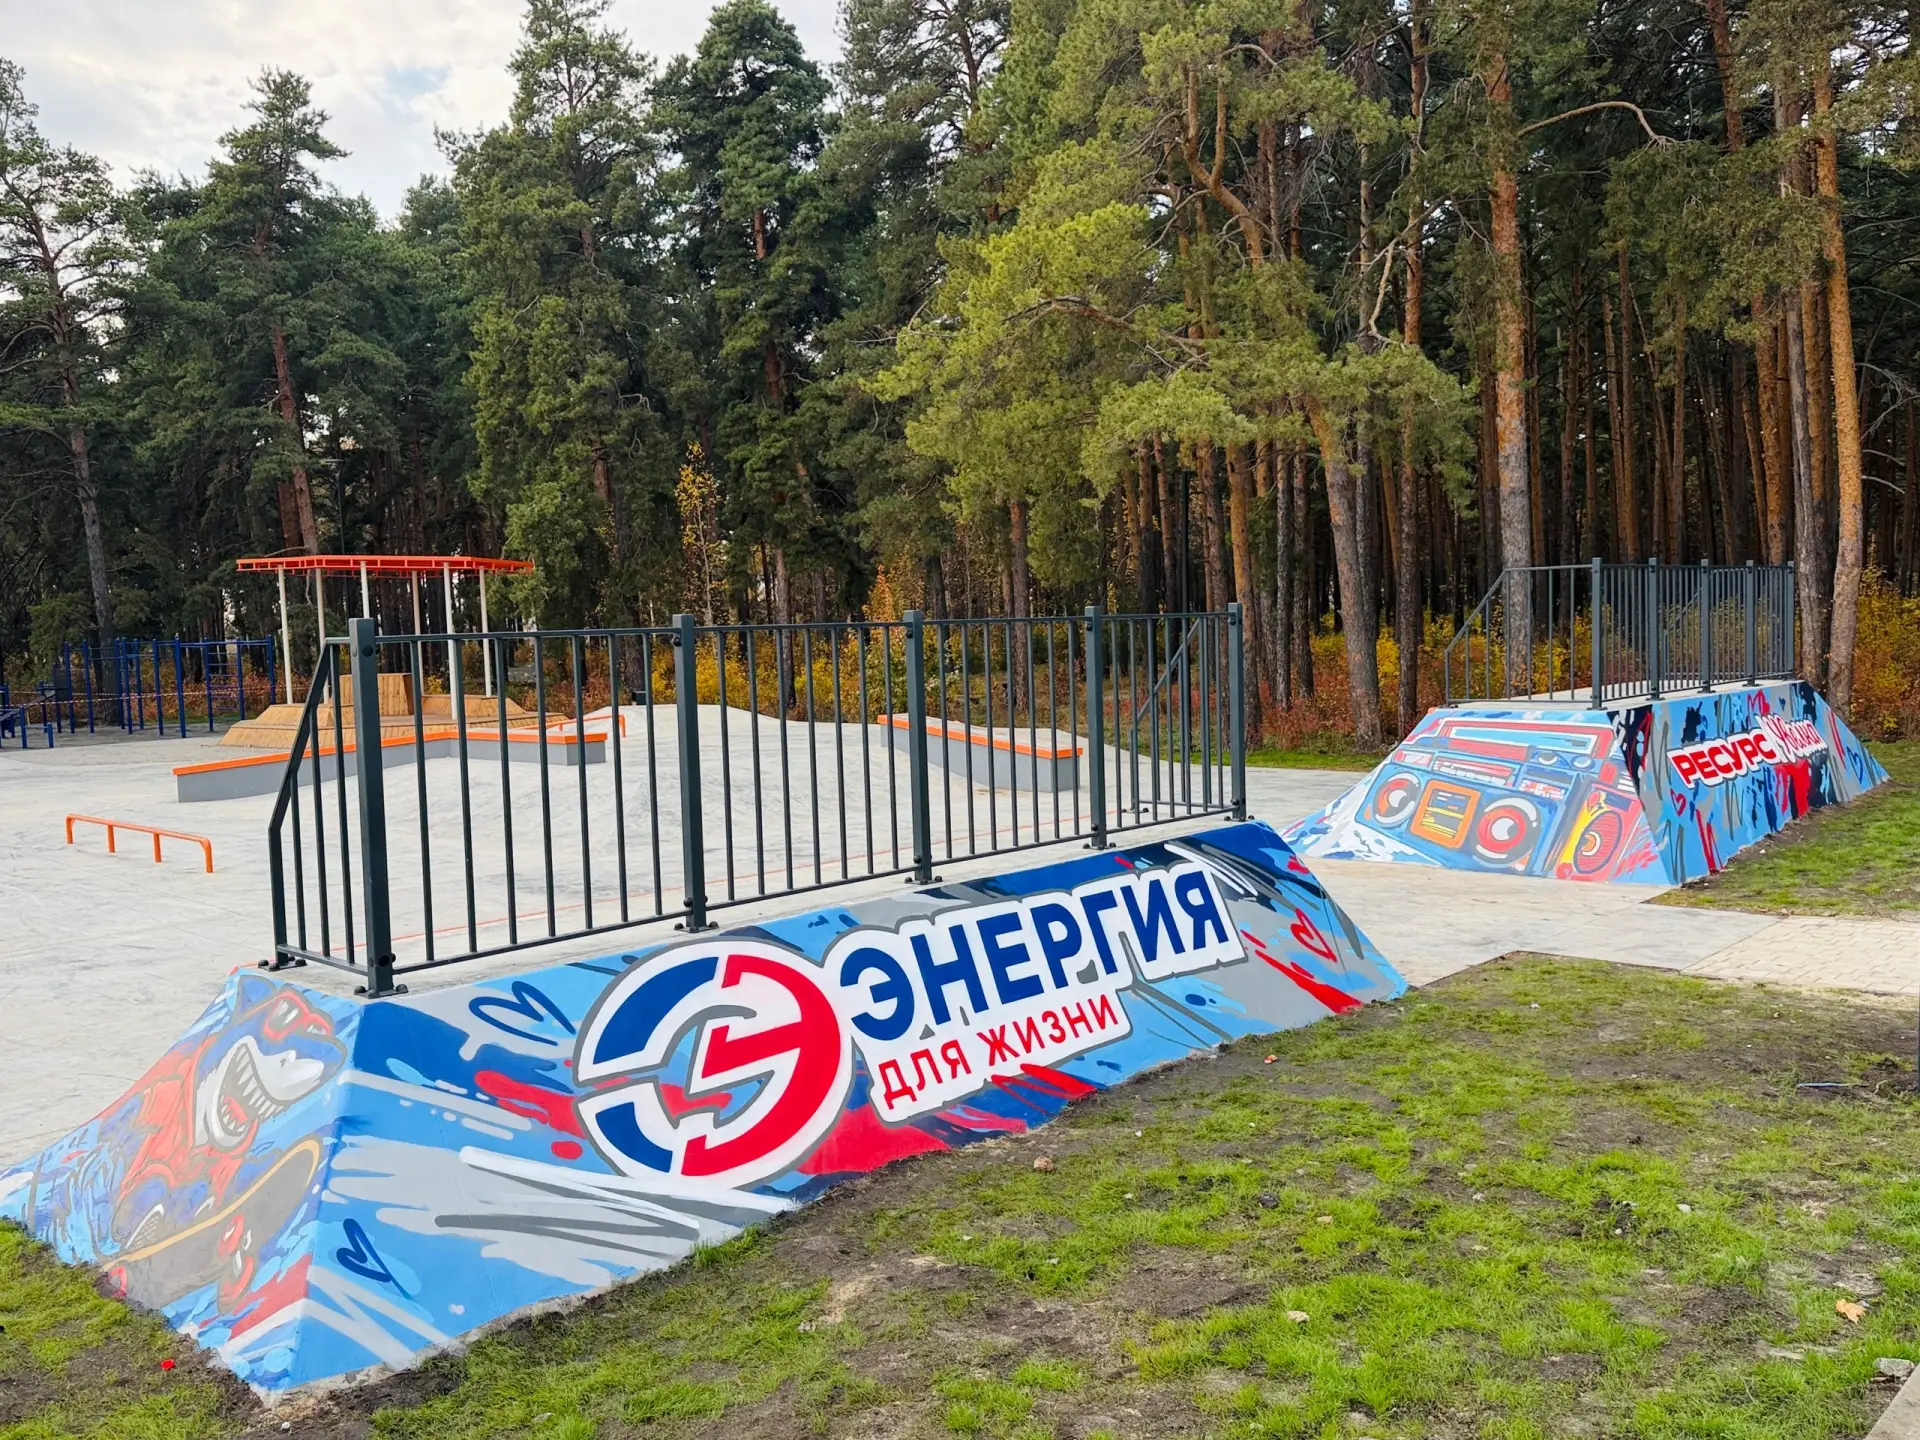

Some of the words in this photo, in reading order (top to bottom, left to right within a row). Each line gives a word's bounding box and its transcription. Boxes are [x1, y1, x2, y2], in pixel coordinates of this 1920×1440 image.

[1671, 733, 1778, 785] РЕСУРС
[839, 869, 1231, 1042] ЭНЕРГИЯ
[877, 1041, 972, 1110] ДЛЯ
[975, 992, 1121, 1066] ЖИЗНИ
